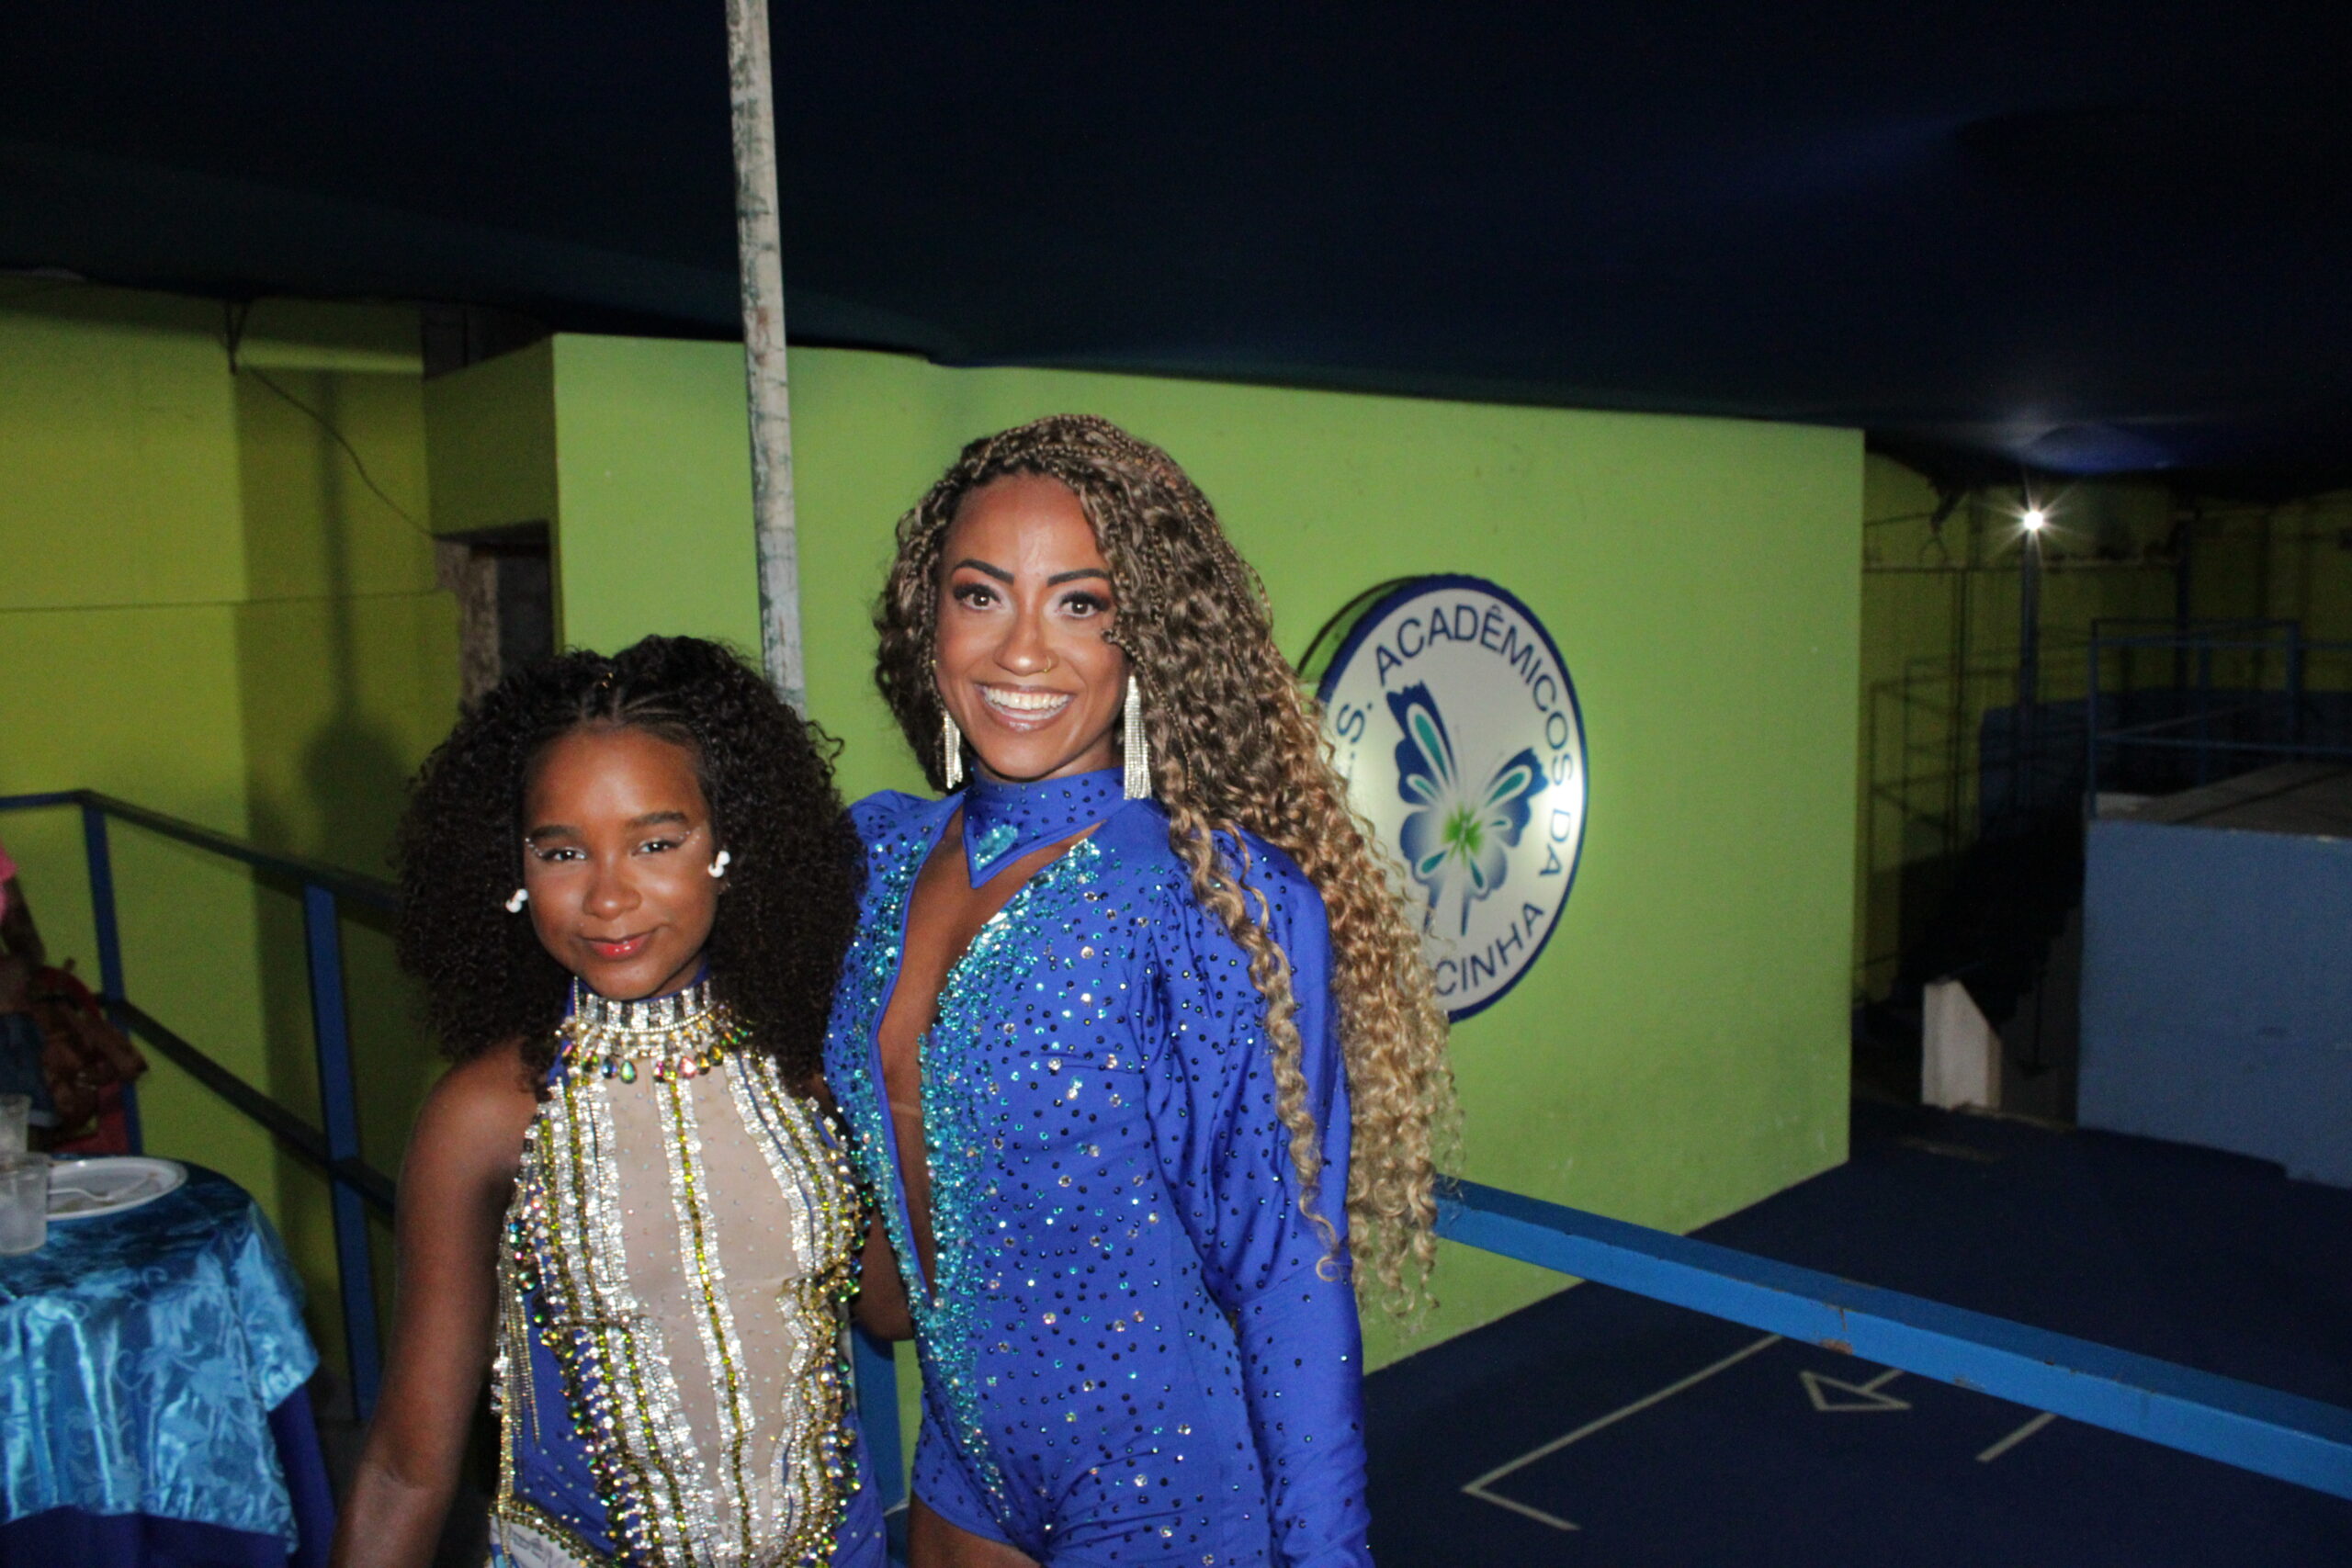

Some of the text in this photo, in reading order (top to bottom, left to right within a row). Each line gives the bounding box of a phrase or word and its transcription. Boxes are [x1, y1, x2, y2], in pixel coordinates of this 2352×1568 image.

[1375, 604, 1573, 786] ACADÊMICOS
[1540, 808, 1572, 878] DA
[1434, 901, 1544, 997] CINHA
